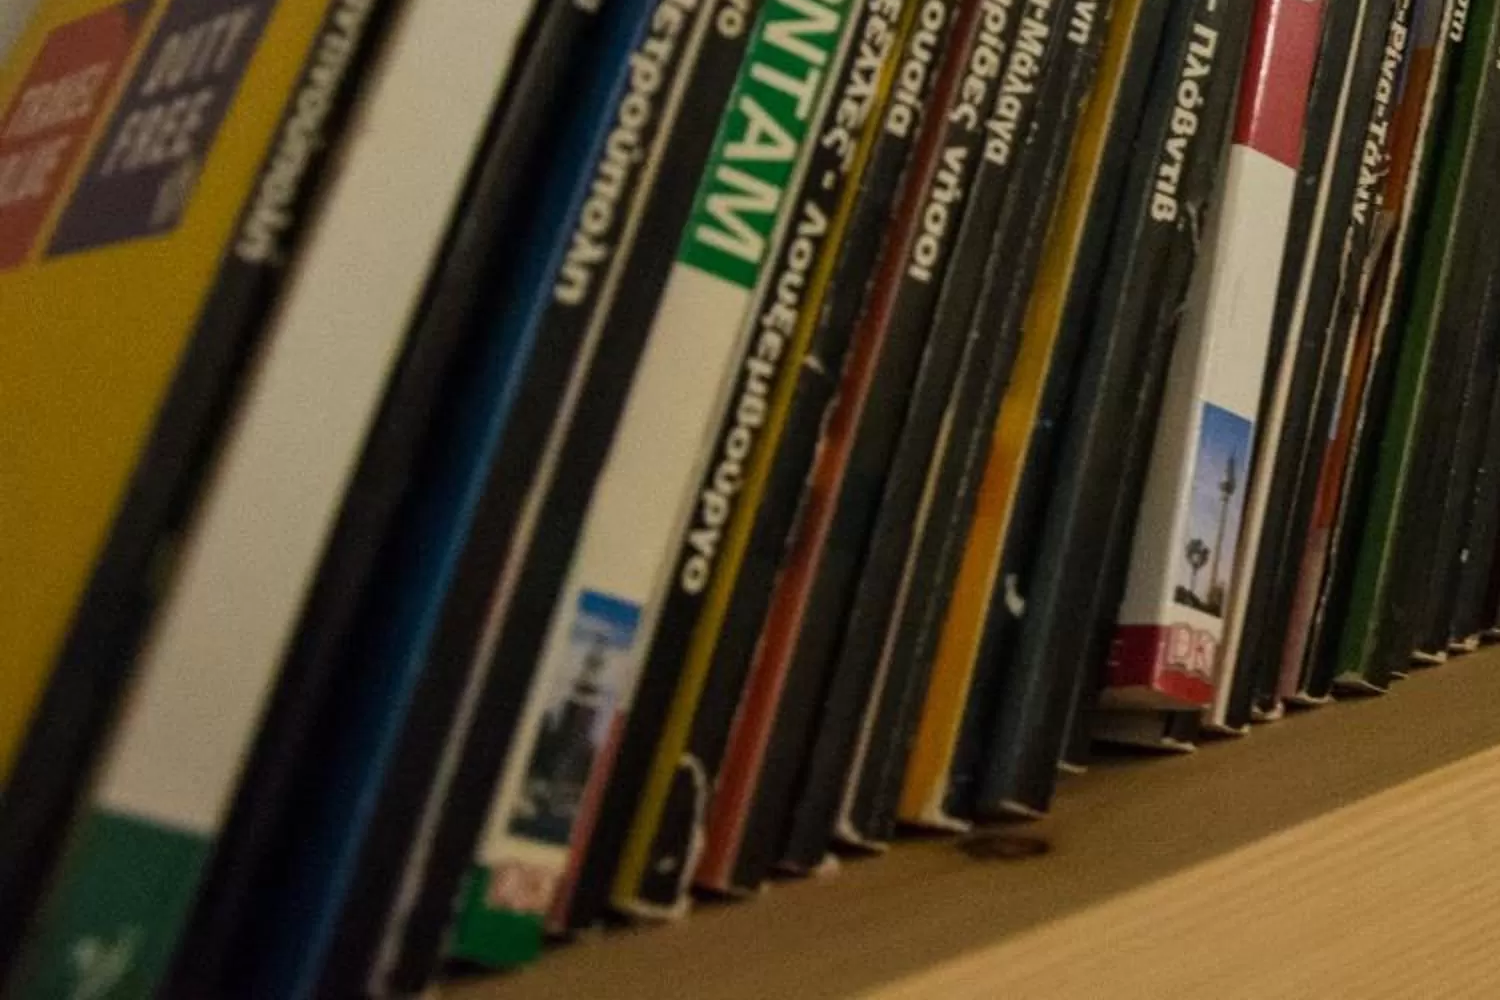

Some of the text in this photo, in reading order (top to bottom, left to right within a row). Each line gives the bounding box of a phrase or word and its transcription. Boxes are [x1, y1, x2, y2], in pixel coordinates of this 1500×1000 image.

[100, 87, 214, 178] FREE
[1150, 22, 1220, 224] Πλόβντιβ
[908, 145, 967, 284] νήσοι
[680, 204, 828, 596] Λουξεμβούργο
